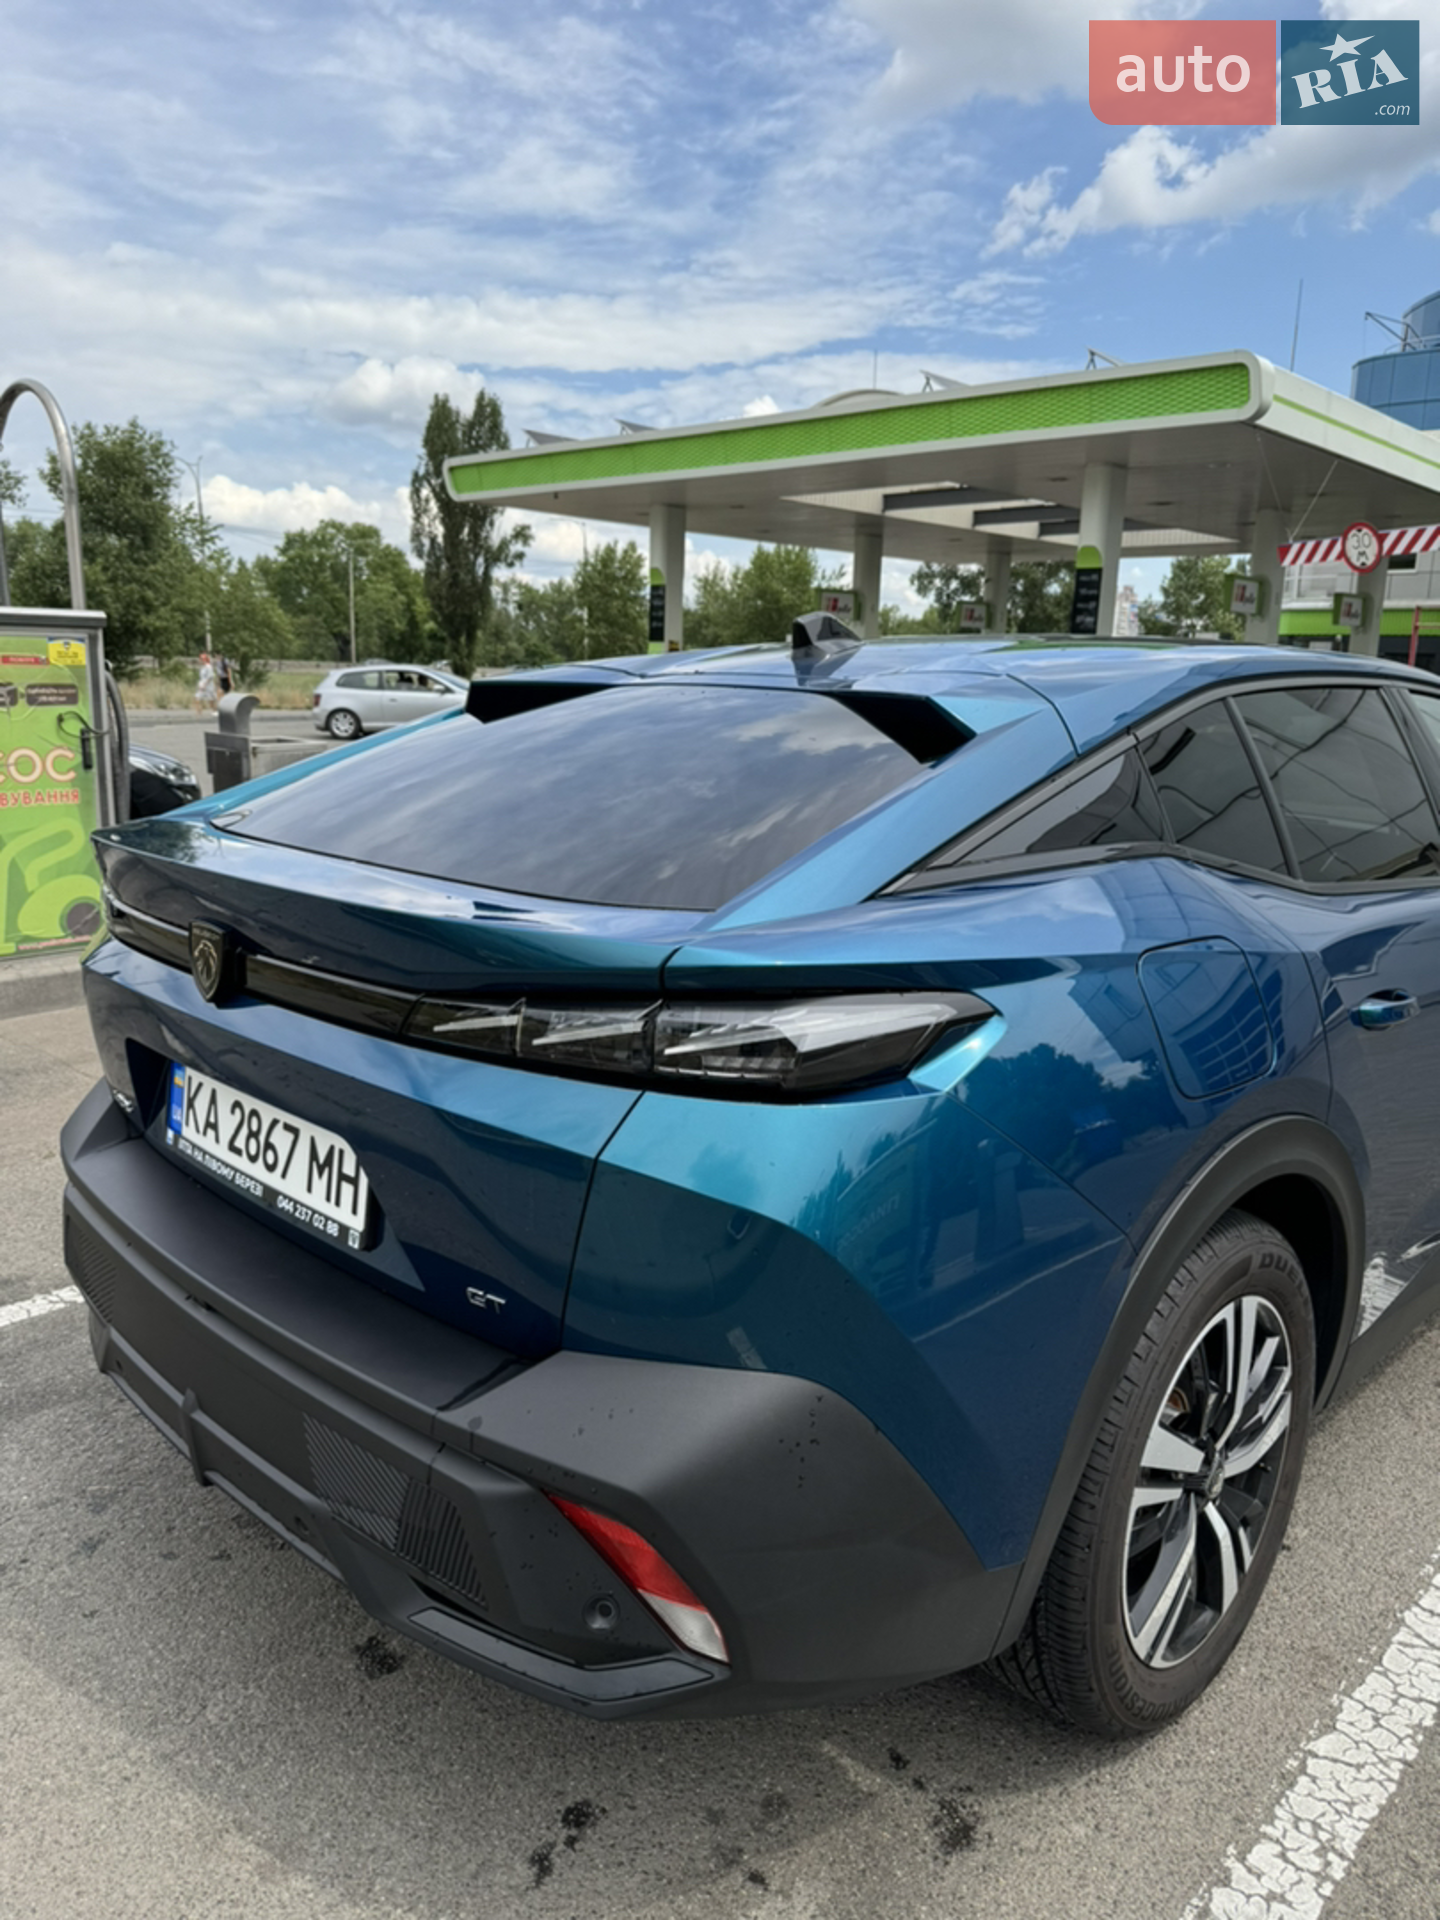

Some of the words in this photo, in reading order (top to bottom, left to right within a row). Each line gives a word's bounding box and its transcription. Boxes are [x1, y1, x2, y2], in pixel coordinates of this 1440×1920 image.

[0, 747, 77, 785] ОС
[184, 1075, 220, 1145] KA
[227, 1099, 300, 1179] 2867
[306, 1135, 361, 1216] MH
[276, 1195, 294, 1214] 044
[466, 1286, 506, 1314] GT
